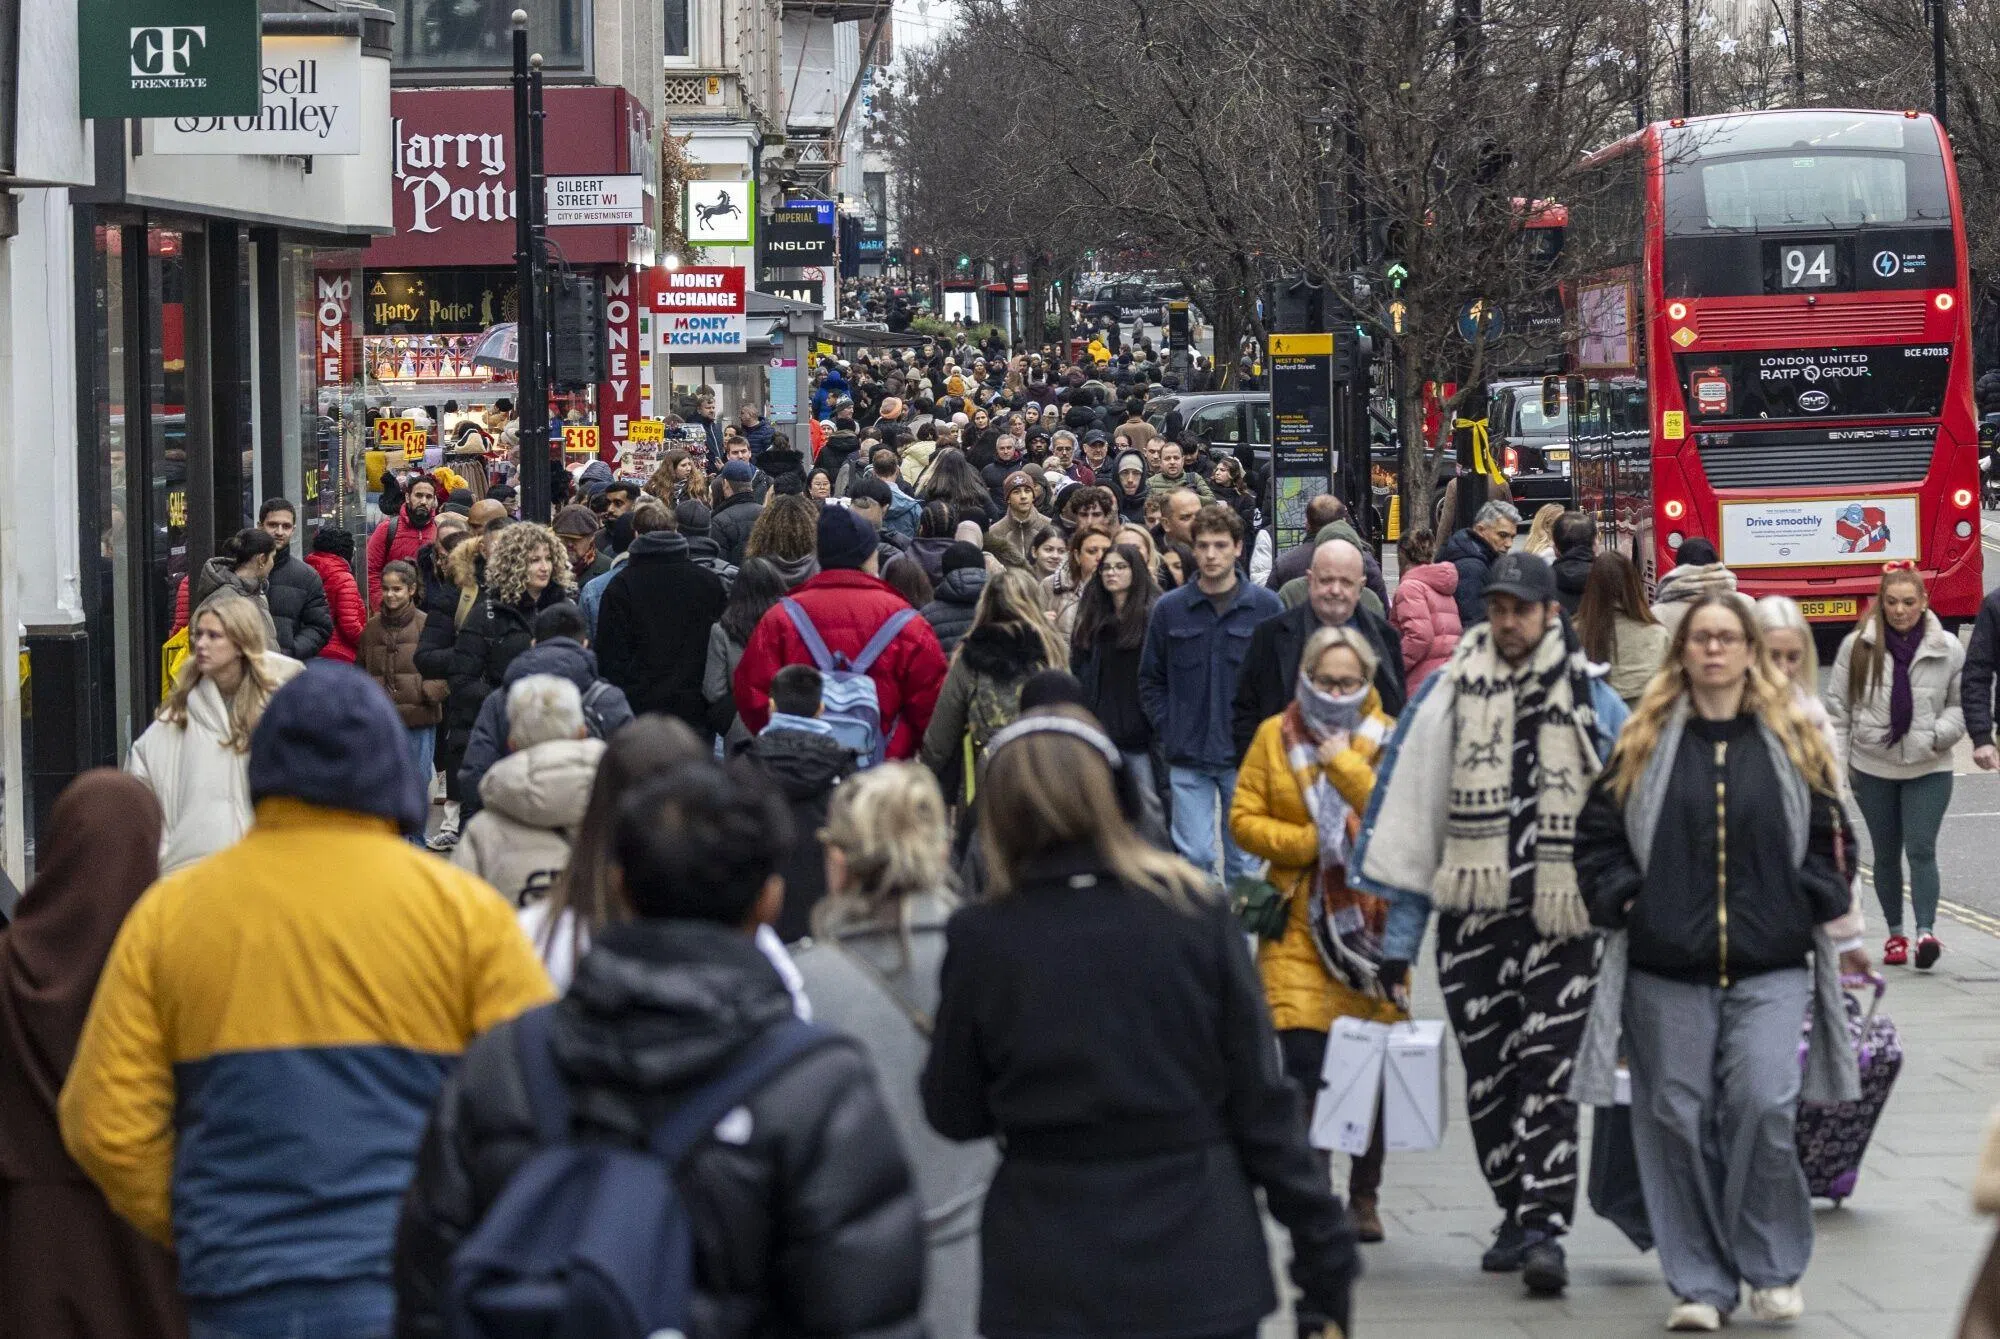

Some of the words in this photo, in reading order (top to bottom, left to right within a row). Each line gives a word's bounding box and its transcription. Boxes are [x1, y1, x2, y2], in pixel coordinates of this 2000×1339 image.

[131, 78, 207, 89] FRENCHEYE
[262, 60, 318, 94] sell
[557, 180, 604, 192] GILBERT
[403, 170, 517, 233] Pott
[557, 194, 599, 206] STREET
[602, 194, 617, 205] W1
[558, 212, 573, 220] CITY
[574, 212, 583, 220] OF
[584, 211, 633, 219] WESTMINSTER
[775, 212, 814, 223] IMPERIAL
[769, 241, 826, 251] INGLOT
[1786, 250, 1831, 284] 94
[671, 273, 724, 288] MONEY
[657, 292, 737, 306] EXCHANGE
[374, 302, 419, 325] Harry
[429, 299, 474, 326] Potter
[675, 317, 728, 330] MONEY
[605, 274, 630, 402] MONEY
[663, 332, 740, 345] EXCHANGE
[1904, 349, 1922, 357] BCE
[1922, 347, 1949, 356] 47018
[1760, 356, 1815, 366] LONDON
[1819, 354, 1868, 364] UNITED
[1760, 369, 1800, 380] RATP
[1822, 366, 1868, 378] GROUP
[1802, 396, 1826, 405] BYD
[379, 421, 411, 441] £18
[407, 434, 425, 455] £18
[565, 429, 596, 447] £18
[1746, 517, 1773, 527] Drive
[1775, 515, 1822, 527] smoothly
[1802, 603, 1825, 614] B69
[1829, 602, 1852, 613] JPU
